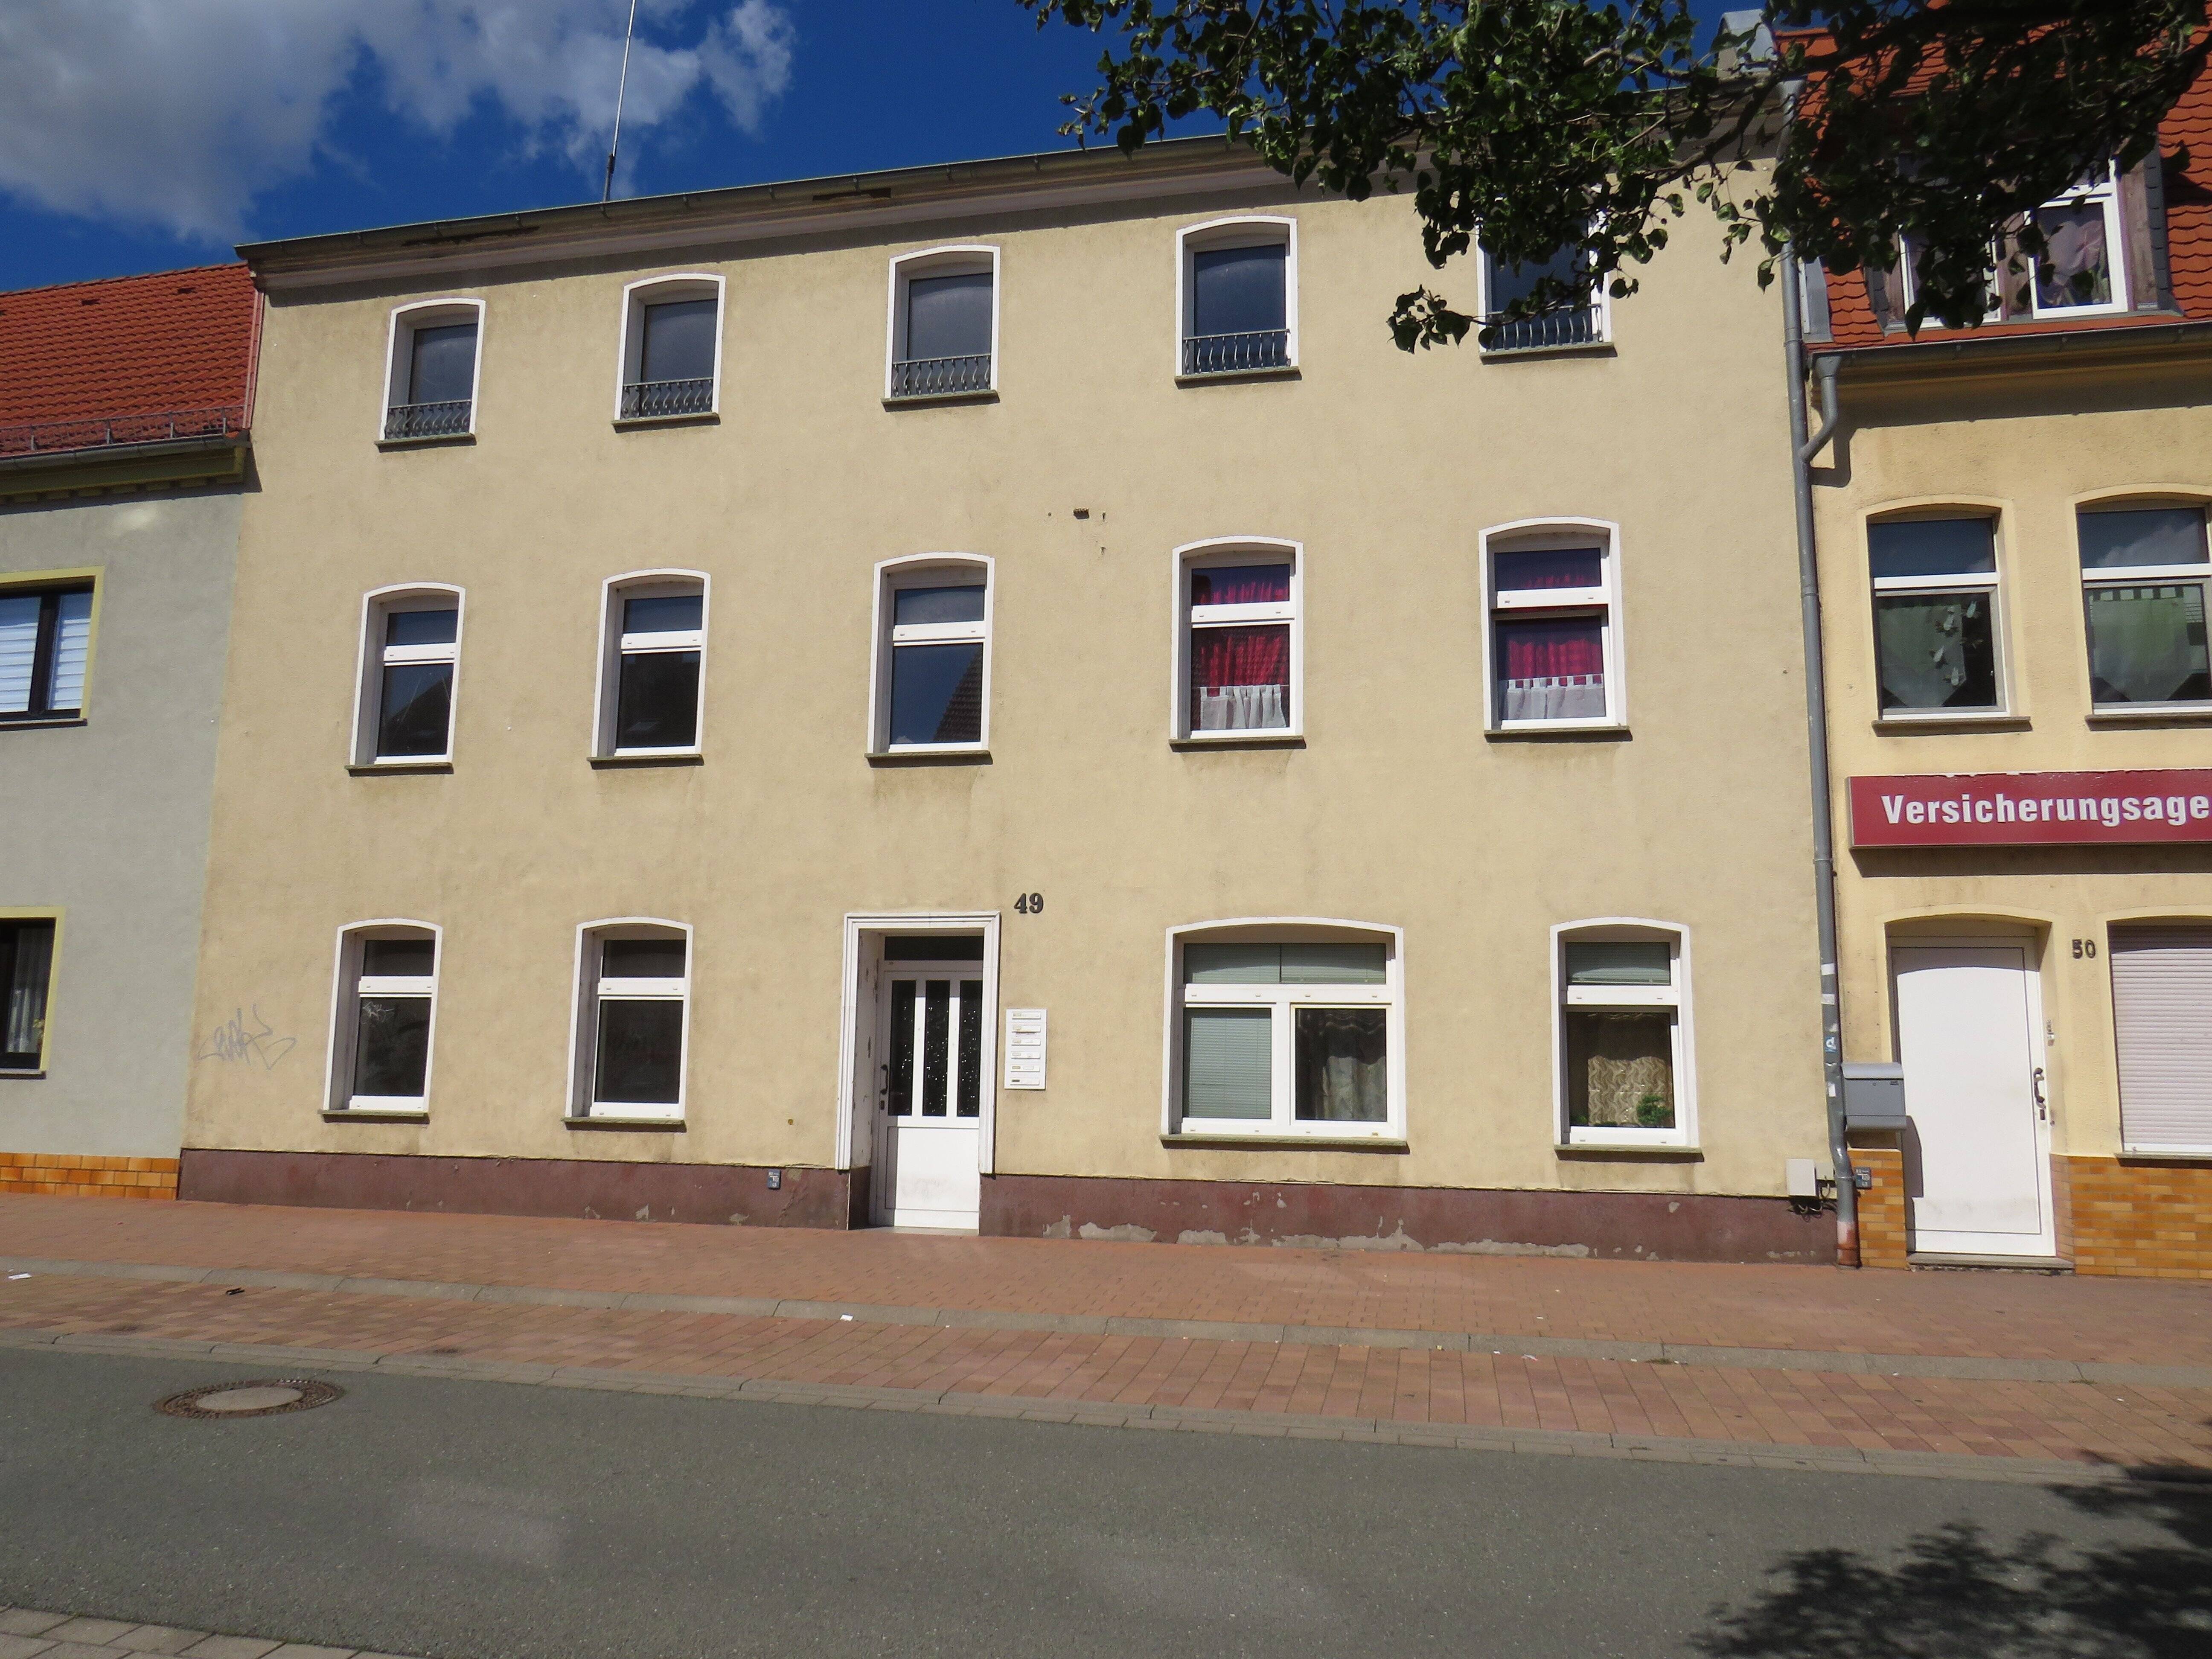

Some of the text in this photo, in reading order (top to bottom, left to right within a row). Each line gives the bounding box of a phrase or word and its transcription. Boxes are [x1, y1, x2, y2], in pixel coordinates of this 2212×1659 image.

[1881, 793, 2209, 827] Versicherungsage
[1014, 893, 1044, 914] 49
[2072, 939, 2096, 959] 50
